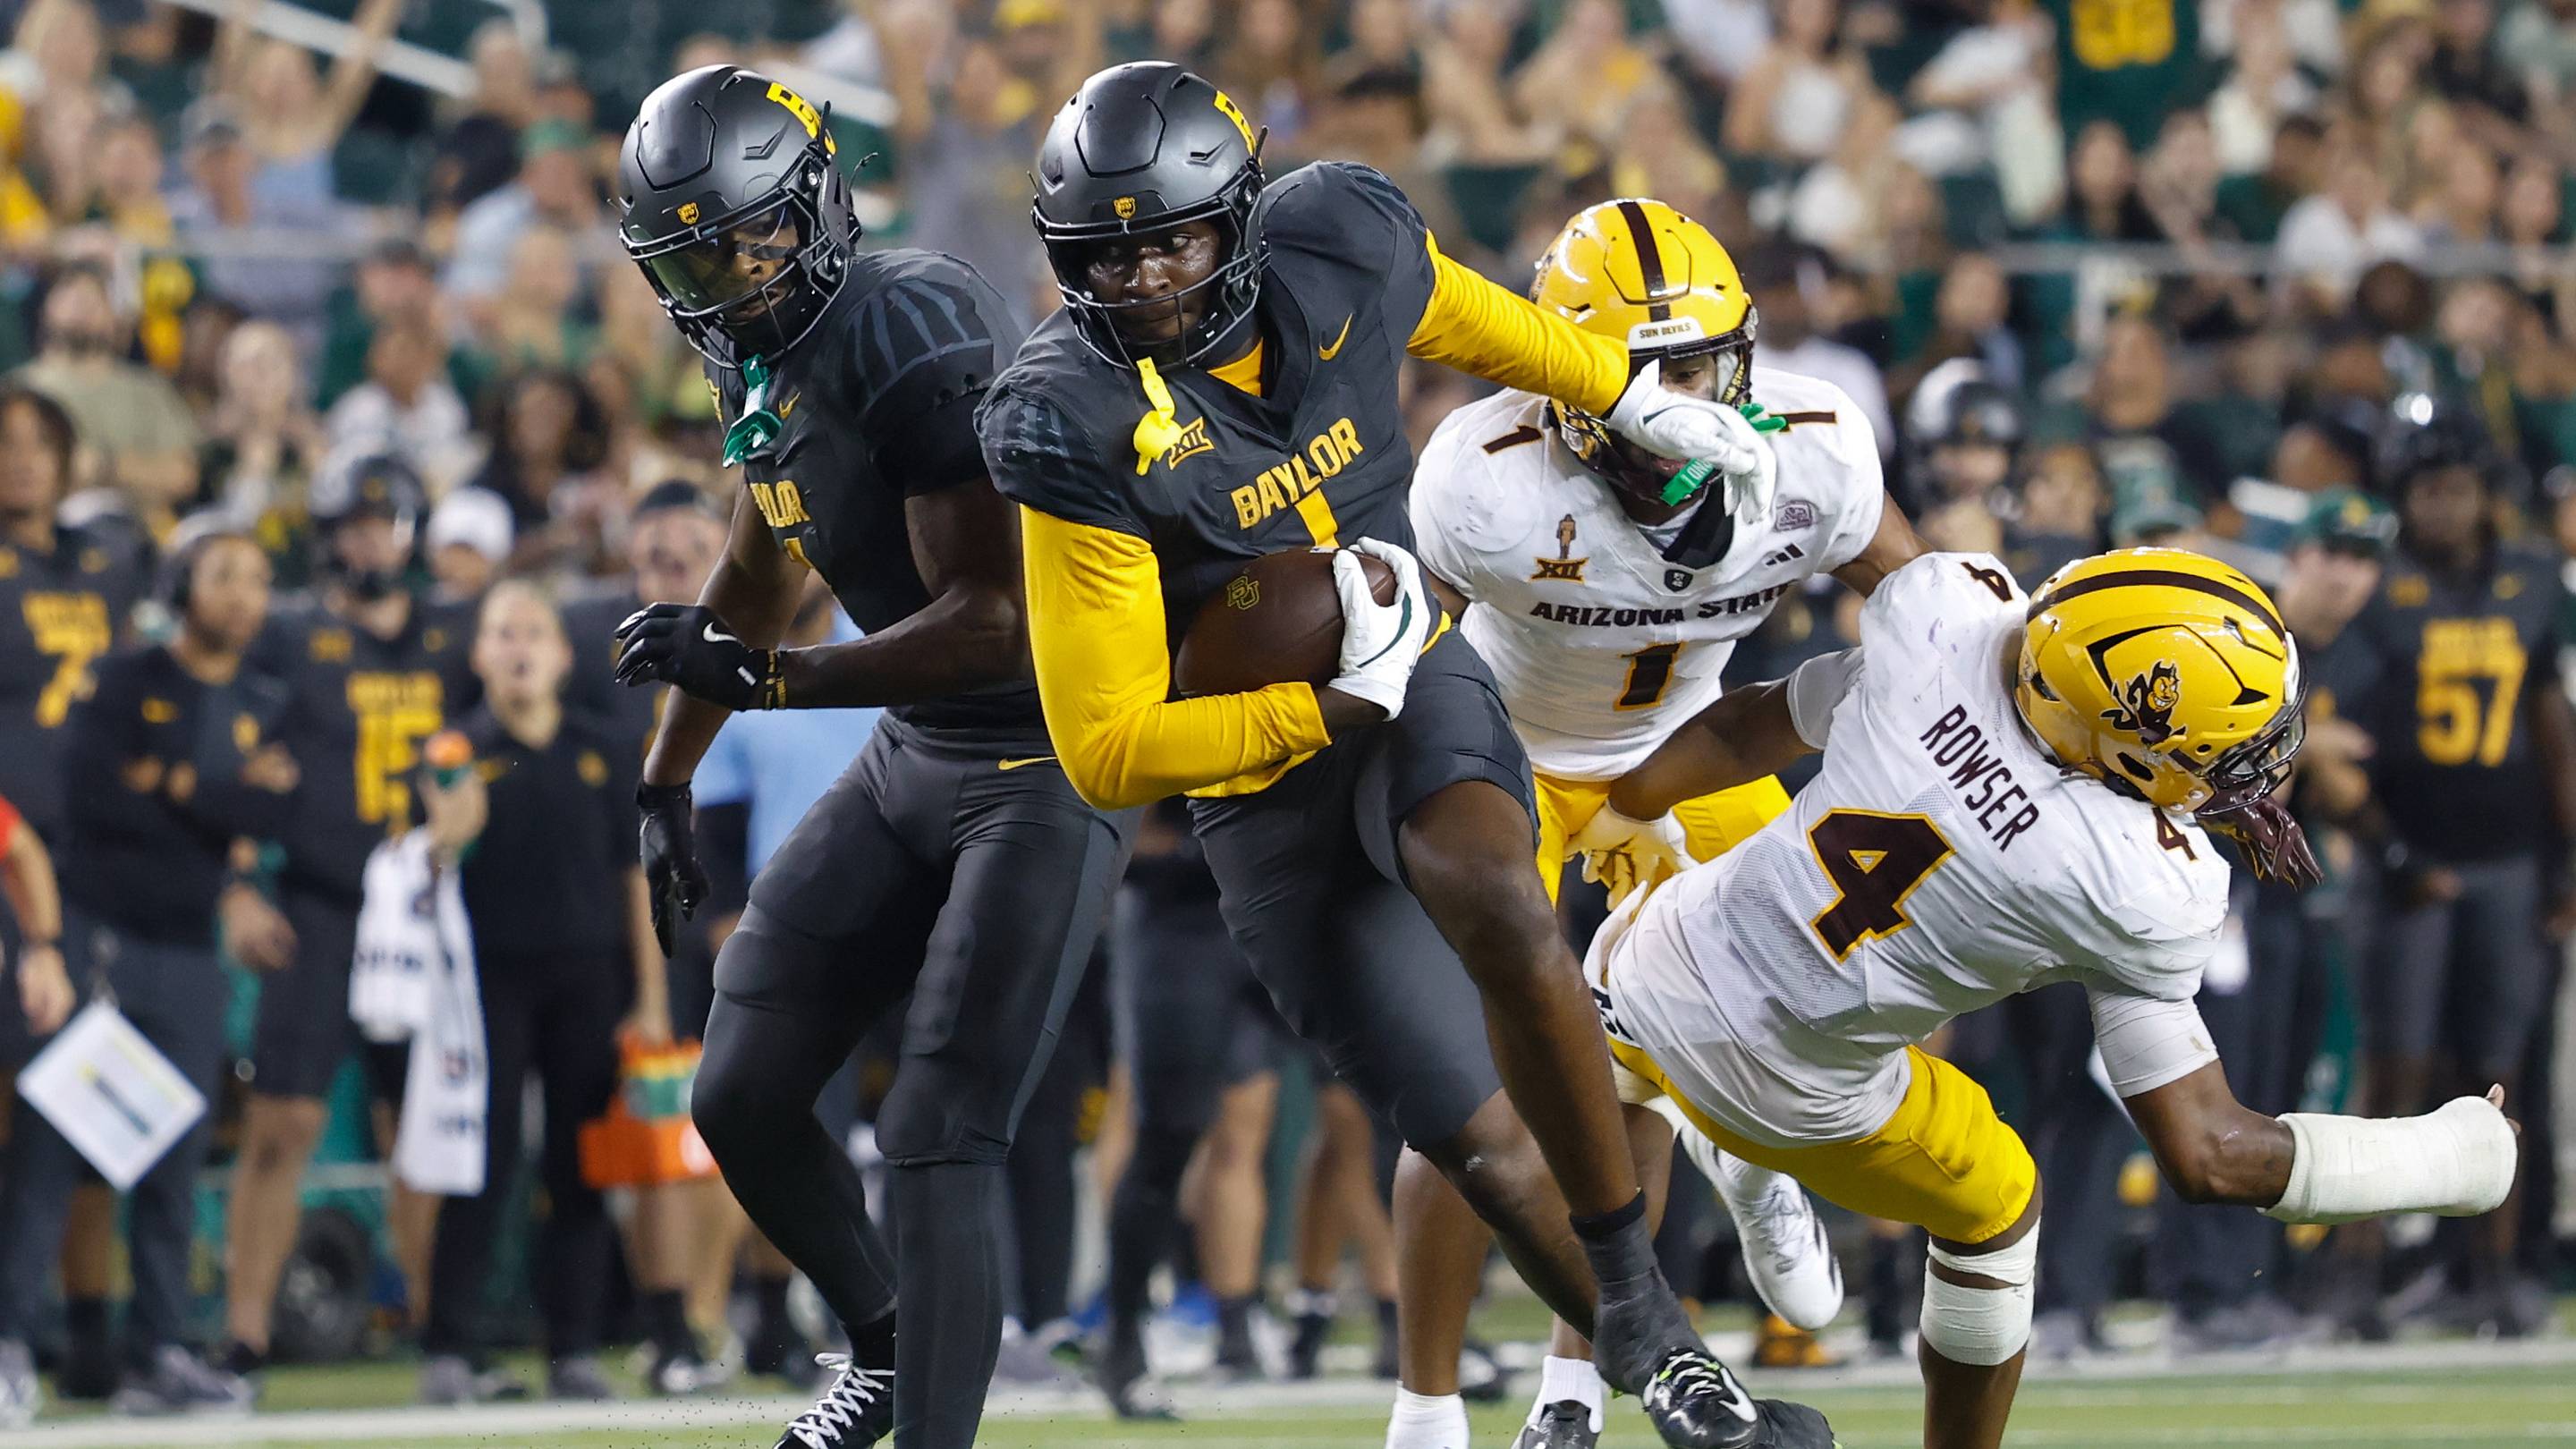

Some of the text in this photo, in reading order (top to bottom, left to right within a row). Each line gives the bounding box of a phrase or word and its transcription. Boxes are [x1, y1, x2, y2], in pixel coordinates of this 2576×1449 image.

[1639, 322, 1691, 339] SUN DEVILS
[1480, 425, 1544, 455] 1
[1230, 417, 1363, 530] BAYLOR
[1226, 574, 1259, 610] BU
[1528, 556, 1589, 584] XII
[1959, 561, 2014, 604] 4
[1530, 582, 1790, 627] ARIZONA STAT
[1613, 640, 1689, 712] 1
[2417, 648, 2530, 767] 57
[1919, 703, 2040, 852] ROWSER
[2151, 806, 2199, 864] 4
[1806, 807, 1957, 965] 4
